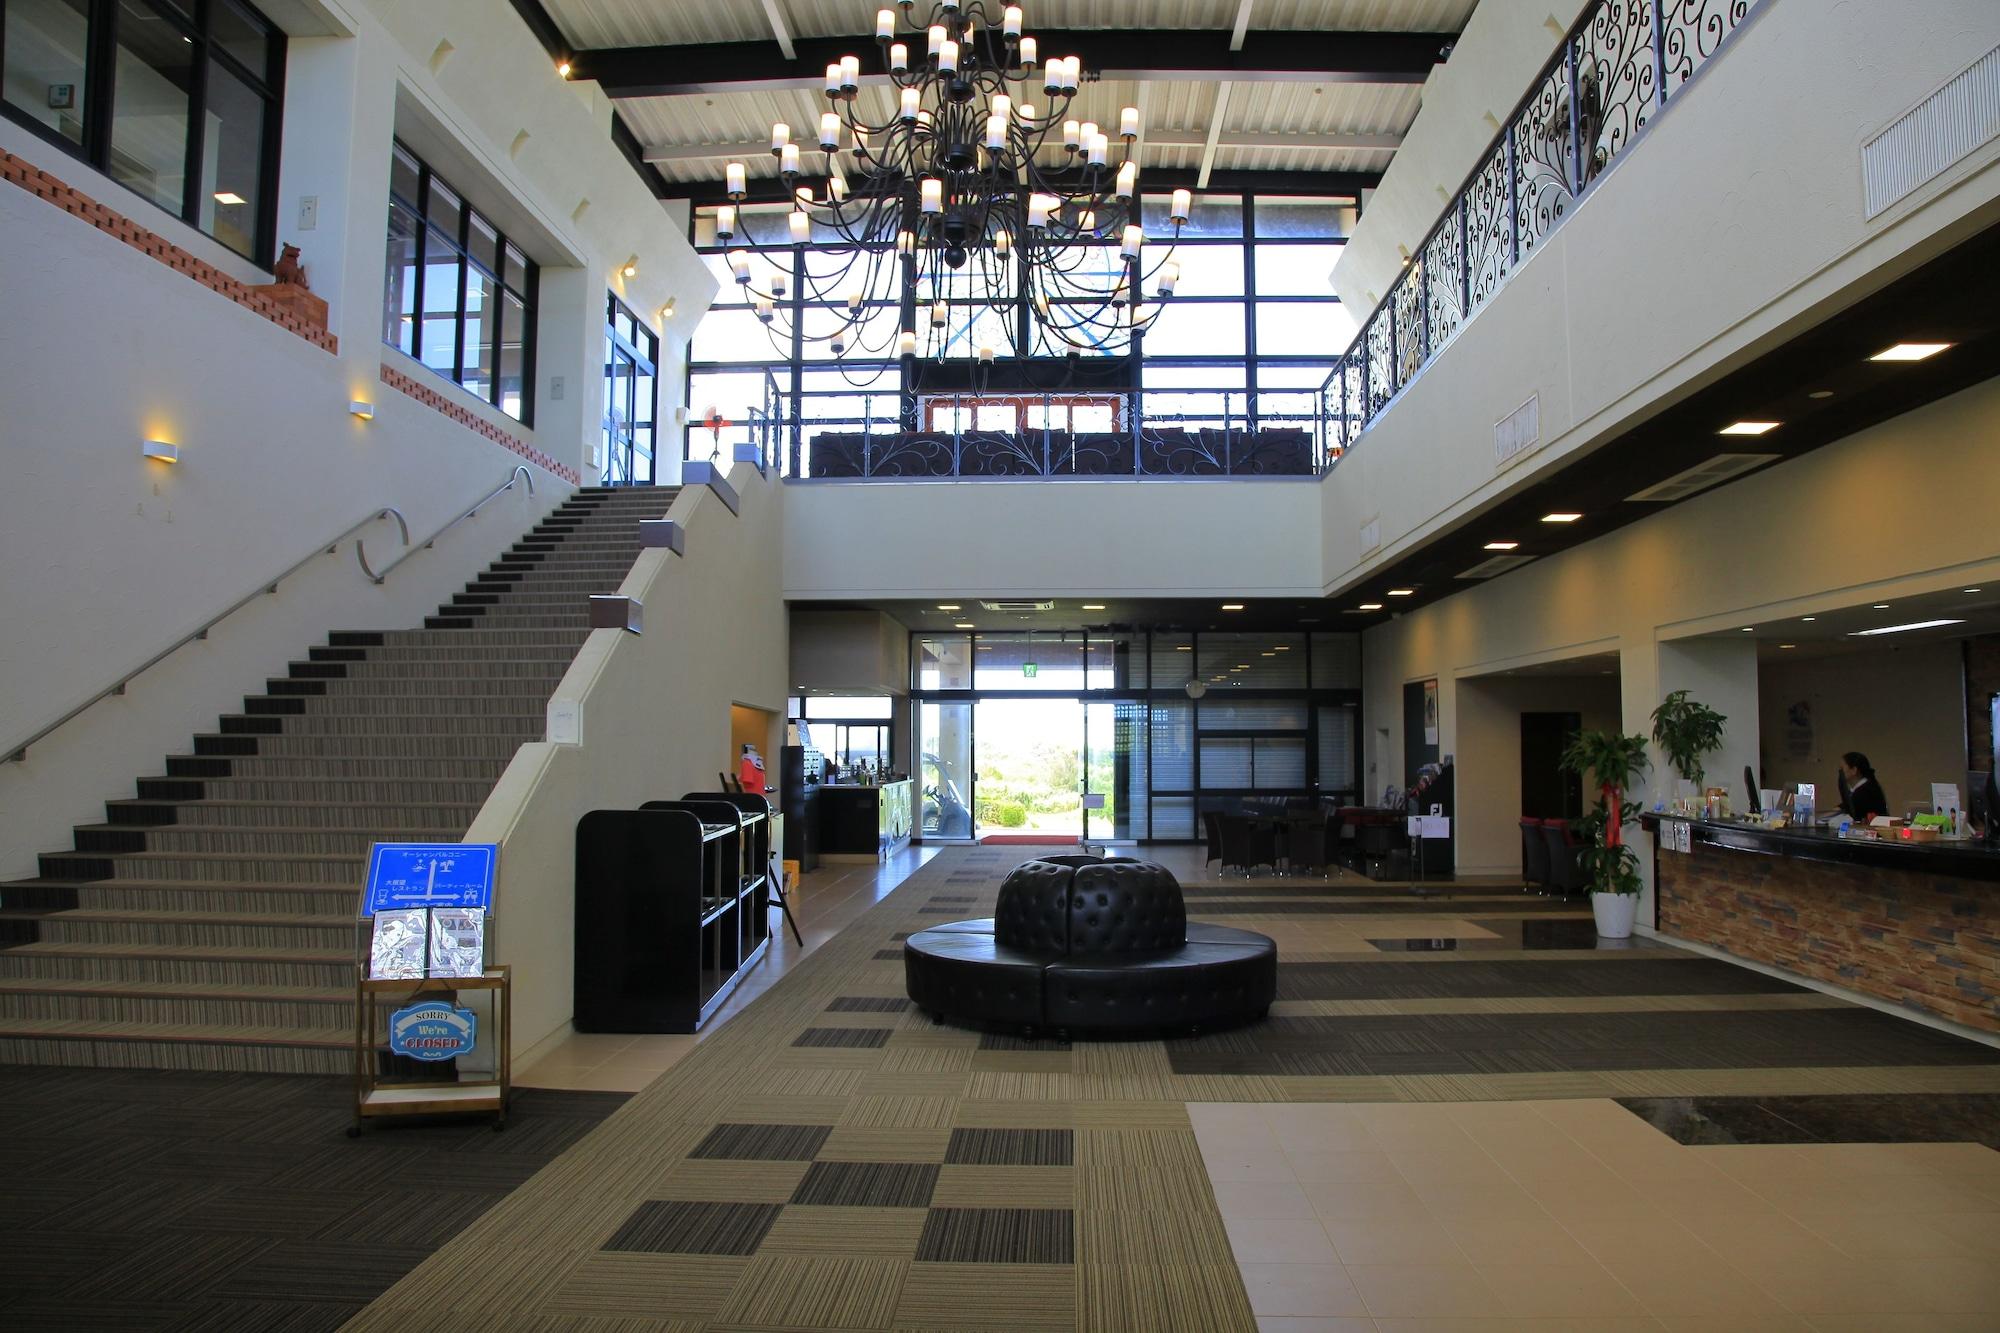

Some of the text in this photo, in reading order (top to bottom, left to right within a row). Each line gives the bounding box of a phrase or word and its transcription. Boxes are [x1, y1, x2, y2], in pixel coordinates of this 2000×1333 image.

[416, 1011, 449, 1021] SORRY
[418, 1025, 448, 1035] We're
[405, 1038, 459, 1048] CLOSED
